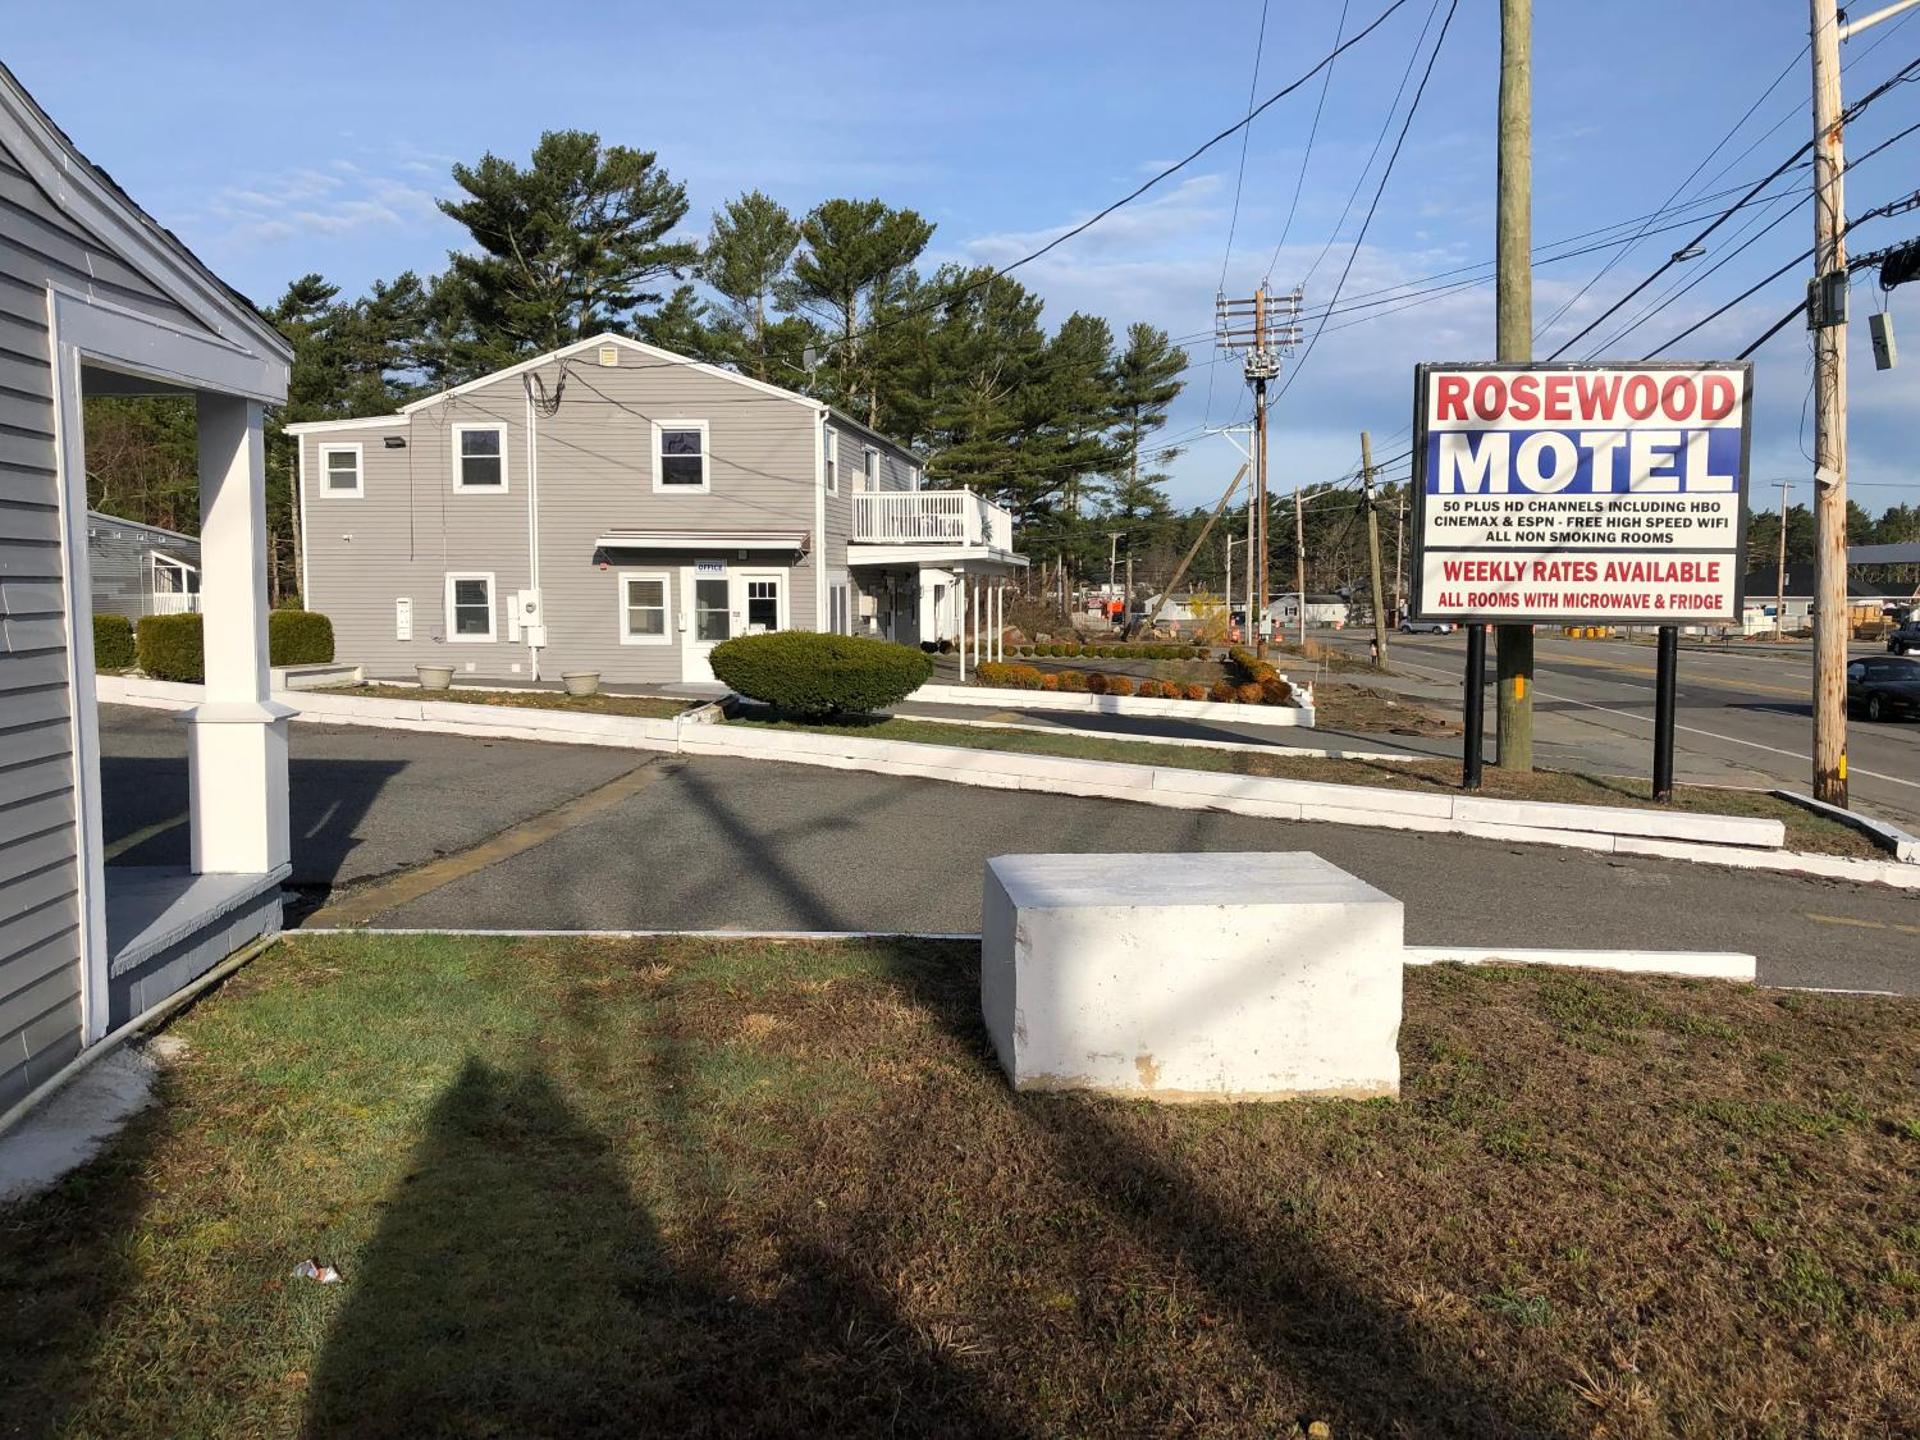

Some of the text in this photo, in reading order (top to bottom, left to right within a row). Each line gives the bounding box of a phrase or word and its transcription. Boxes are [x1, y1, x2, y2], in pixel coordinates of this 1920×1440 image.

[1437, 375, 1736, 421] ROSEWOOD
[1438, 431, 1733, 494] MOTEL
[1443, 502, 1721, 512] 50 PLUS HD CHANNELS INCLUDING HBO
[1434, 517, 1499, 527] CINEMAX
[1503, 517, 1513, 527] &
[1517, 517, 1554, 527] ESPN
[1567, 517, 1602, 527] FREE
[1606, 517, 1641, 528] HIGH
[1646, 517, 1692, 528] SPEED
[1697, 518, 1728, 528] WIFI
[1486, 532, 1673, 543] ALL NON SMOKING ROOMS
[1444, 561, 1719, 582] WEEKLY RATES AVAILABLE
[1439, 592, 1722, 609] ALL ROOMS WITH MICROWAVE & FRIDGE
